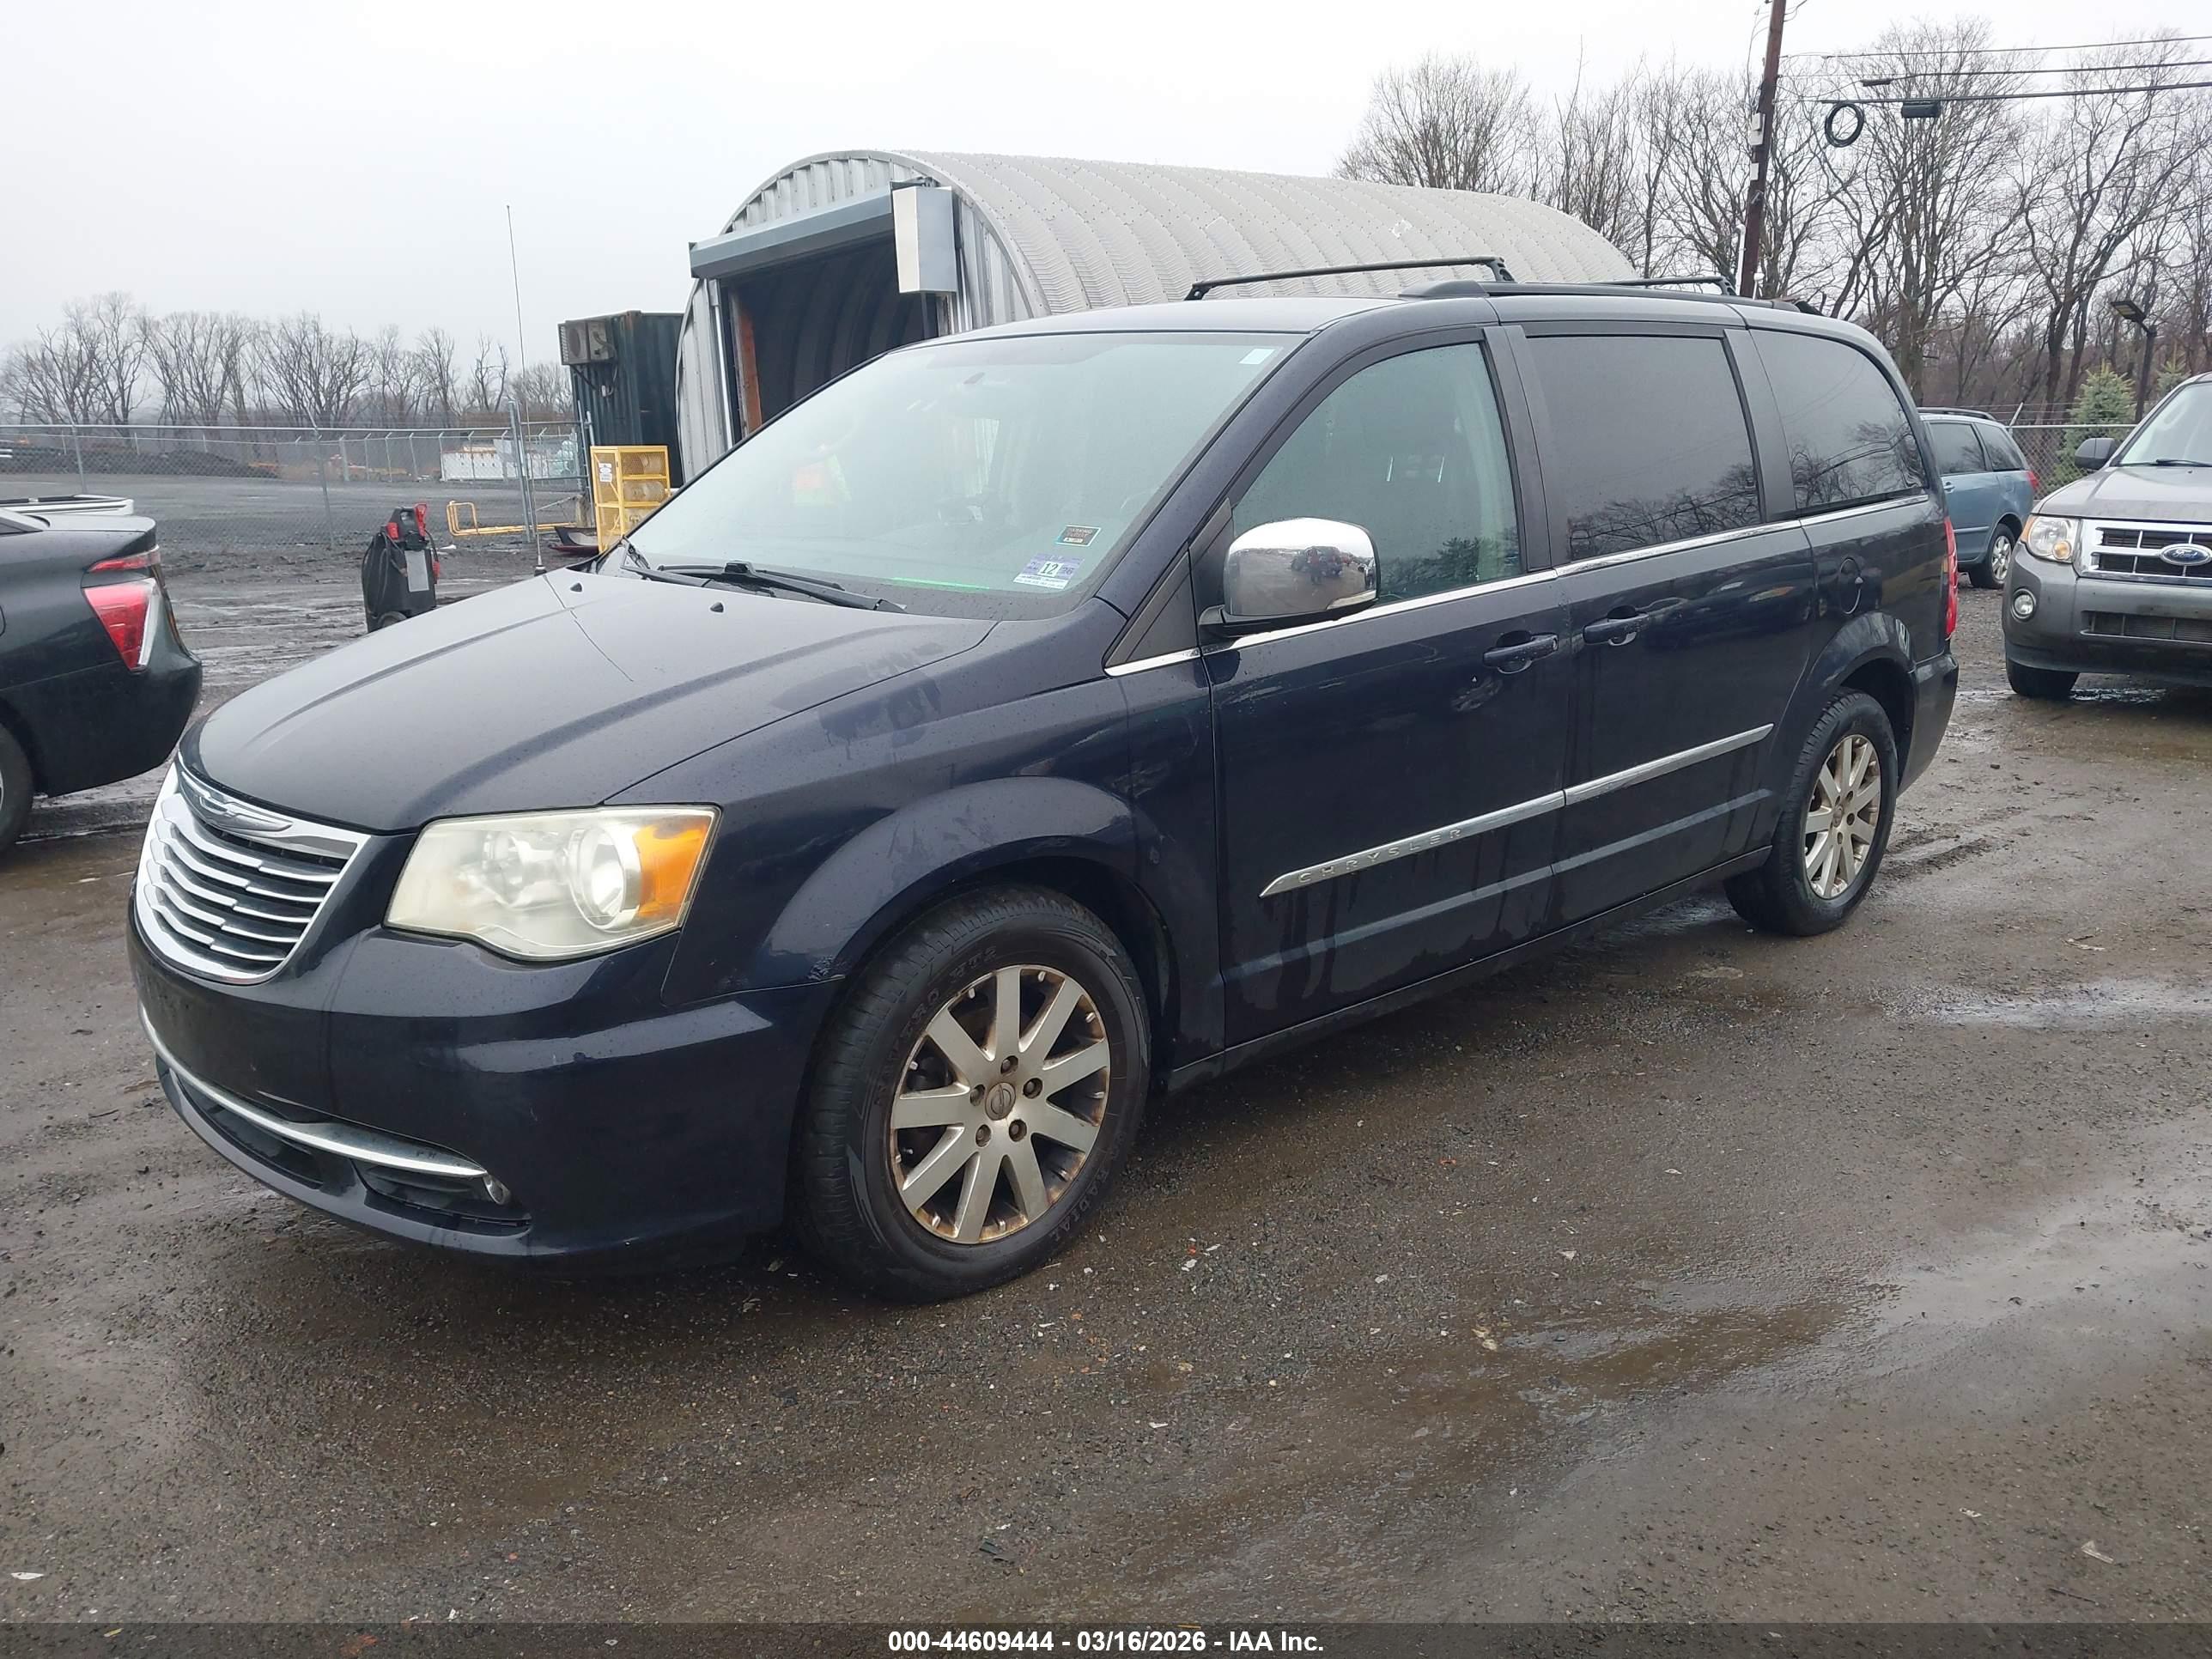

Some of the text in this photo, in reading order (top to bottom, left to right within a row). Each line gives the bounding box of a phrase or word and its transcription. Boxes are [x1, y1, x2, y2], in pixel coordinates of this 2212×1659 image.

[1040, 562, 1060, 575] 12
[2172, 548, 2197, 558] Ford
[1298, 828, 1462, 884] CHRYSLER
[1048, 1167, 1109, 1242] RADIAL
